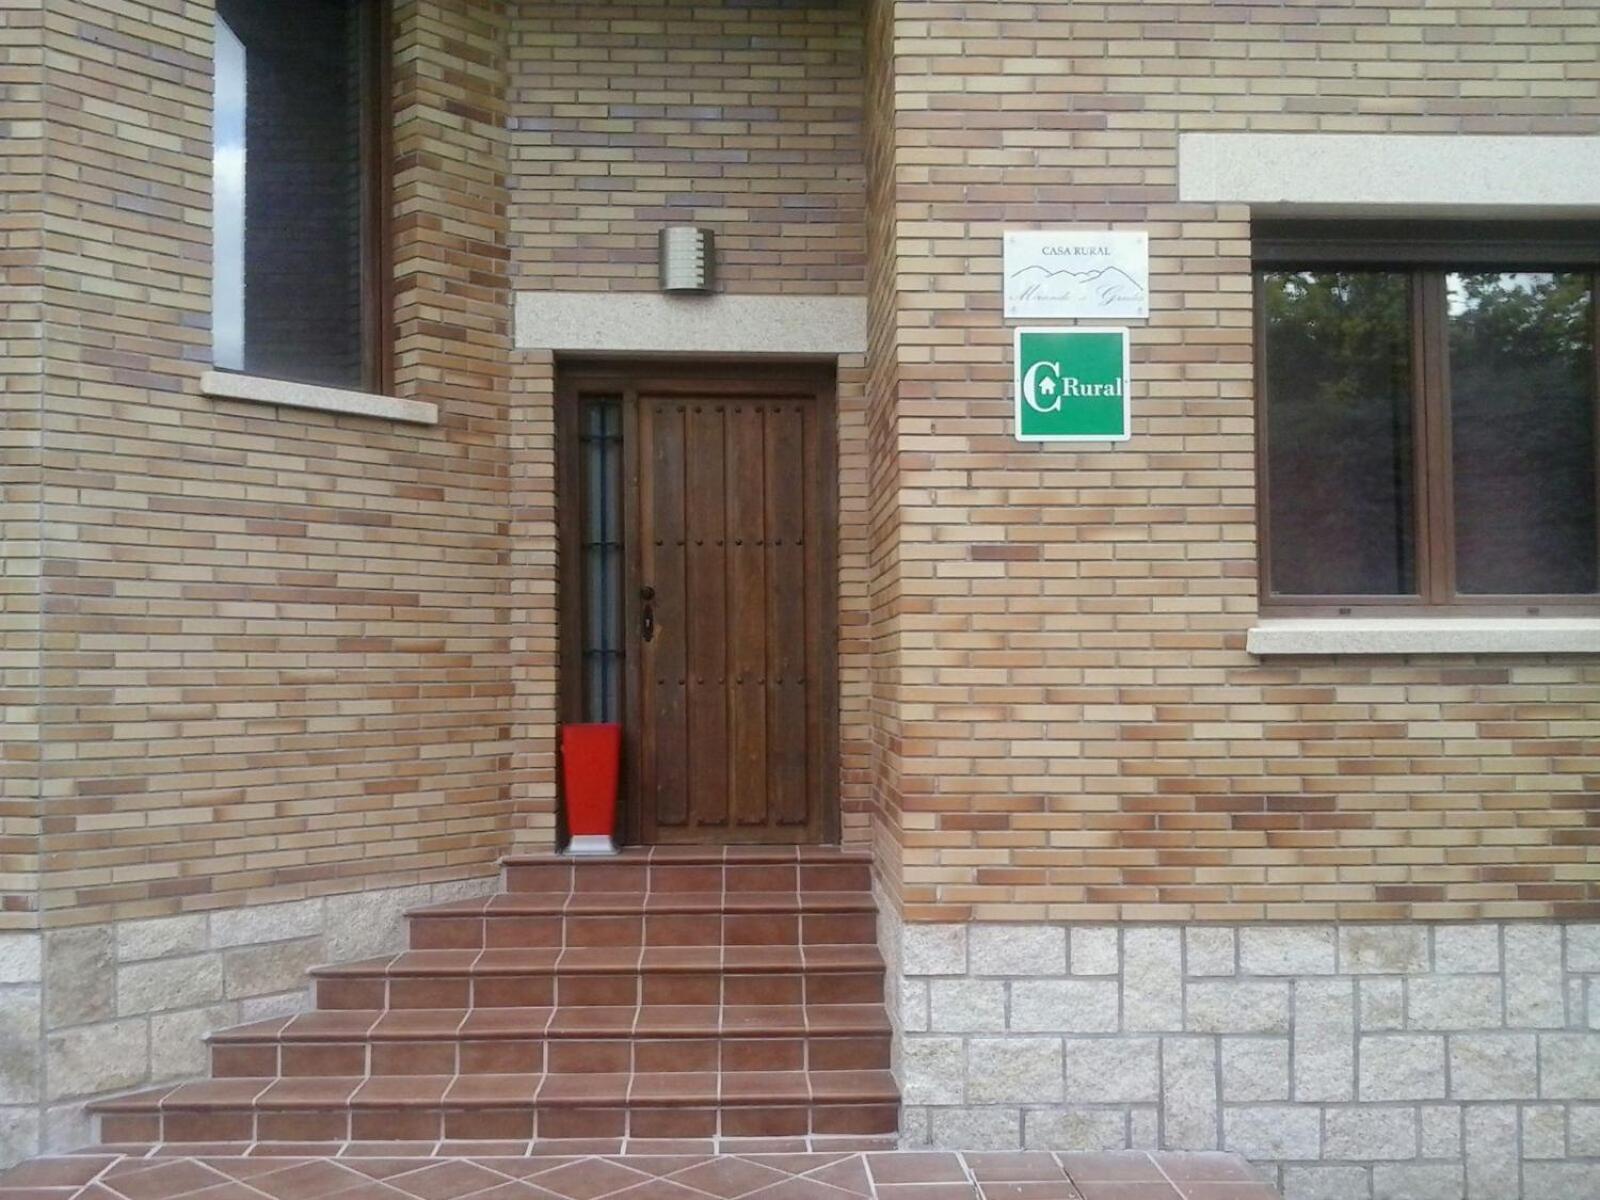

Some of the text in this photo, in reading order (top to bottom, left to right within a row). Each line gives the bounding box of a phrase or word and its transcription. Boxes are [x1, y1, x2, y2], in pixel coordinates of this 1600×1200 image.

[1042, 246, 1110, 256] CASA RURAL
[1023, 361, 1122, 412] C Rural
